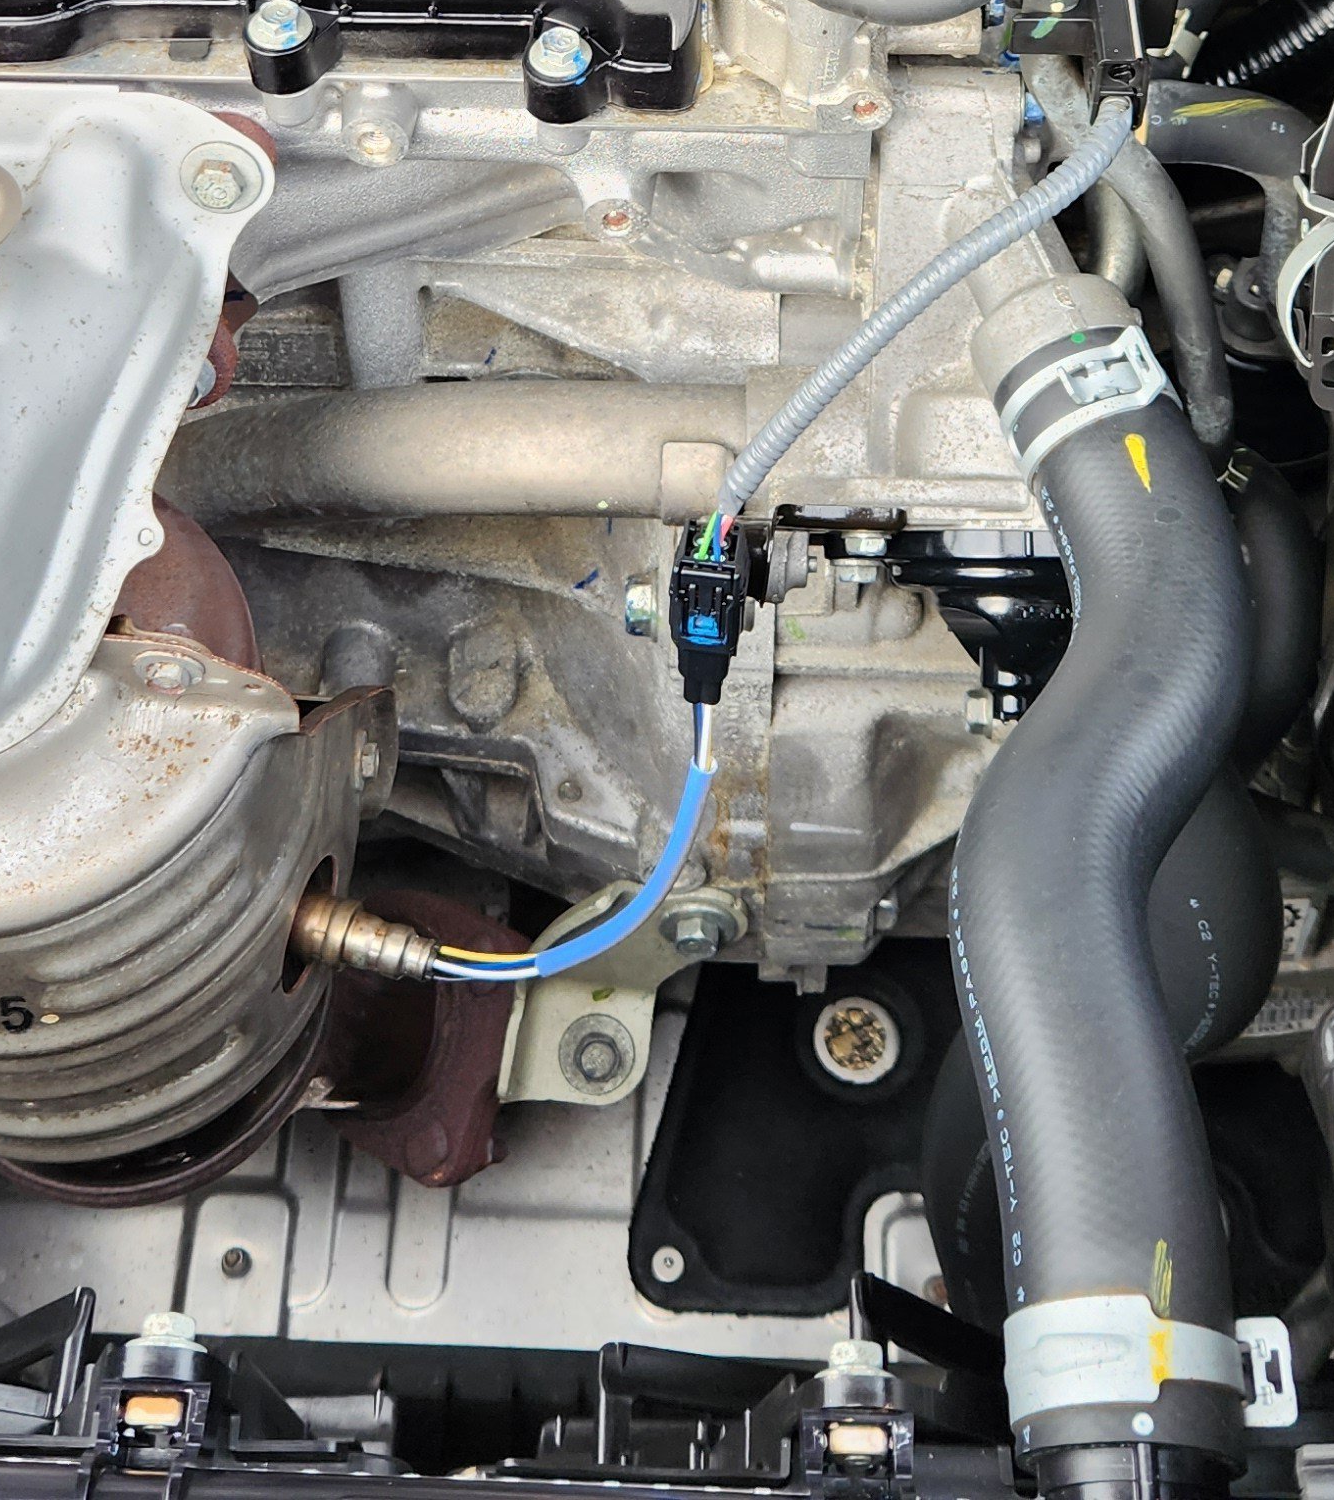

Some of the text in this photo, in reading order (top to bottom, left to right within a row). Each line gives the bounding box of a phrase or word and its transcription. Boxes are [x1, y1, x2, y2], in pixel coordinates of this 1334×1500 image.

[1197, 919, 1220, 1000] C2 Y-TEC
[1000, 1126, 1019, 1213] Y-TEC
[1012, 1230, 1022, 1267] C2
